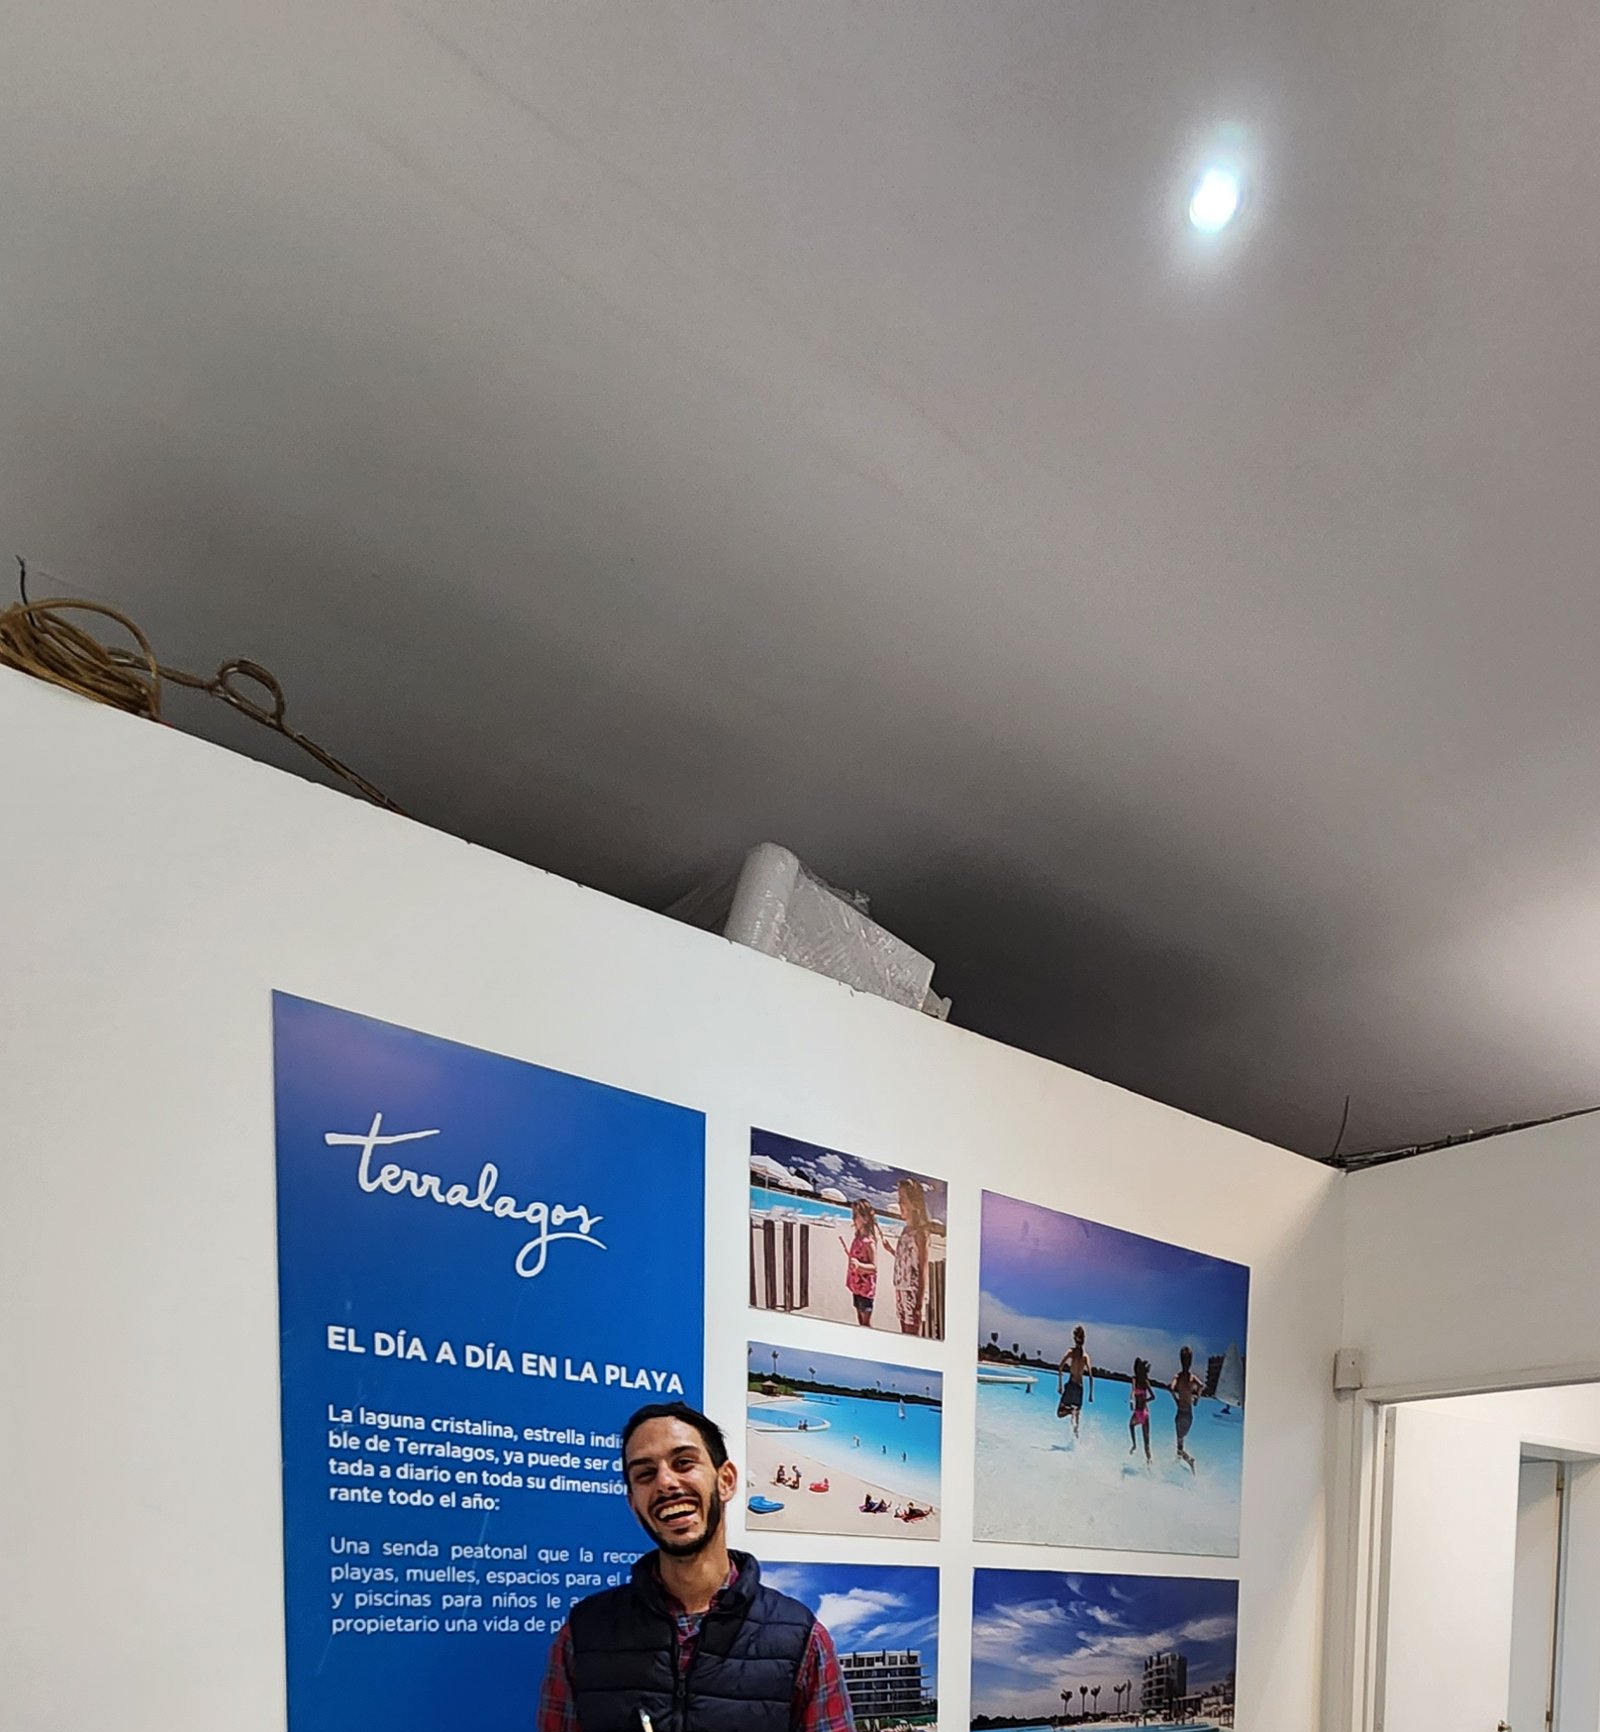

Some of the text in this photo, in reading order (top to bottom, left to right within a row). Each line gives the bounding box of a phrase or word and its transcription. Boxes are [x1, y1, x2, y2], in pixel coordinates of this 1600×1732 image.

[327, 1325, 684, 1395] EL DÍA A DÍA EN LA PLAYA
[328, 1404, 353, 1424] La
[359, 1406, 426, 1430] laguna
[430, 1416, 519, 1442] cristalina,
[523, 1427, 586, 1446] estrella
[328, 1430, 361, 1450] ble
[364, 1434, 391, 1453] de
[394, 1436, 500, 1465] Terralagos,
[502, 1450, 525, 1466] ya
[527, 1452, 581, 1469] puede
[583, 1457, 610, 1471] ser
[328, 1458, 375, 1477] tada
[379, 1464, 392, 1479] a
[395, 1462, 452, 1483] diario
[454, 1470, 478, 1485] en
[481, 1470, 523, 1488] toda
[526, 1476, 546, 1490] su
[329, 1486, 500, 1511] rante todo el año:
[330, 1536, 370, 1555] Una
[382, 1540, 439, 1557] senda
[451, 1543, 527, 1561] peatonal
[537, 1549, 570, 1564] que
[579, 1547, 594, 1563] la
[331, 1563, 399, 1584] playas,
[406, 1566, 480, 1585] muelles,
[486, 1569, 560, 1587] espacios
[565, 1573, 602, 1588] para
[606, 1572, 621, 1587] el
[331, 1593, 344, 1609] y
[355, 1589, 432, 1609] piscinas
[442, 1594, 482, 1610] para
[492, 1592, 538, 1608] niños
[546, 1593, 561, 1609] le
[332, 1614, 440, 1635] propietario
[444, 1618, 478, 1632] una
[483, 1616, 520, 1632] vida
[524, 1616, 546, 1632] de
